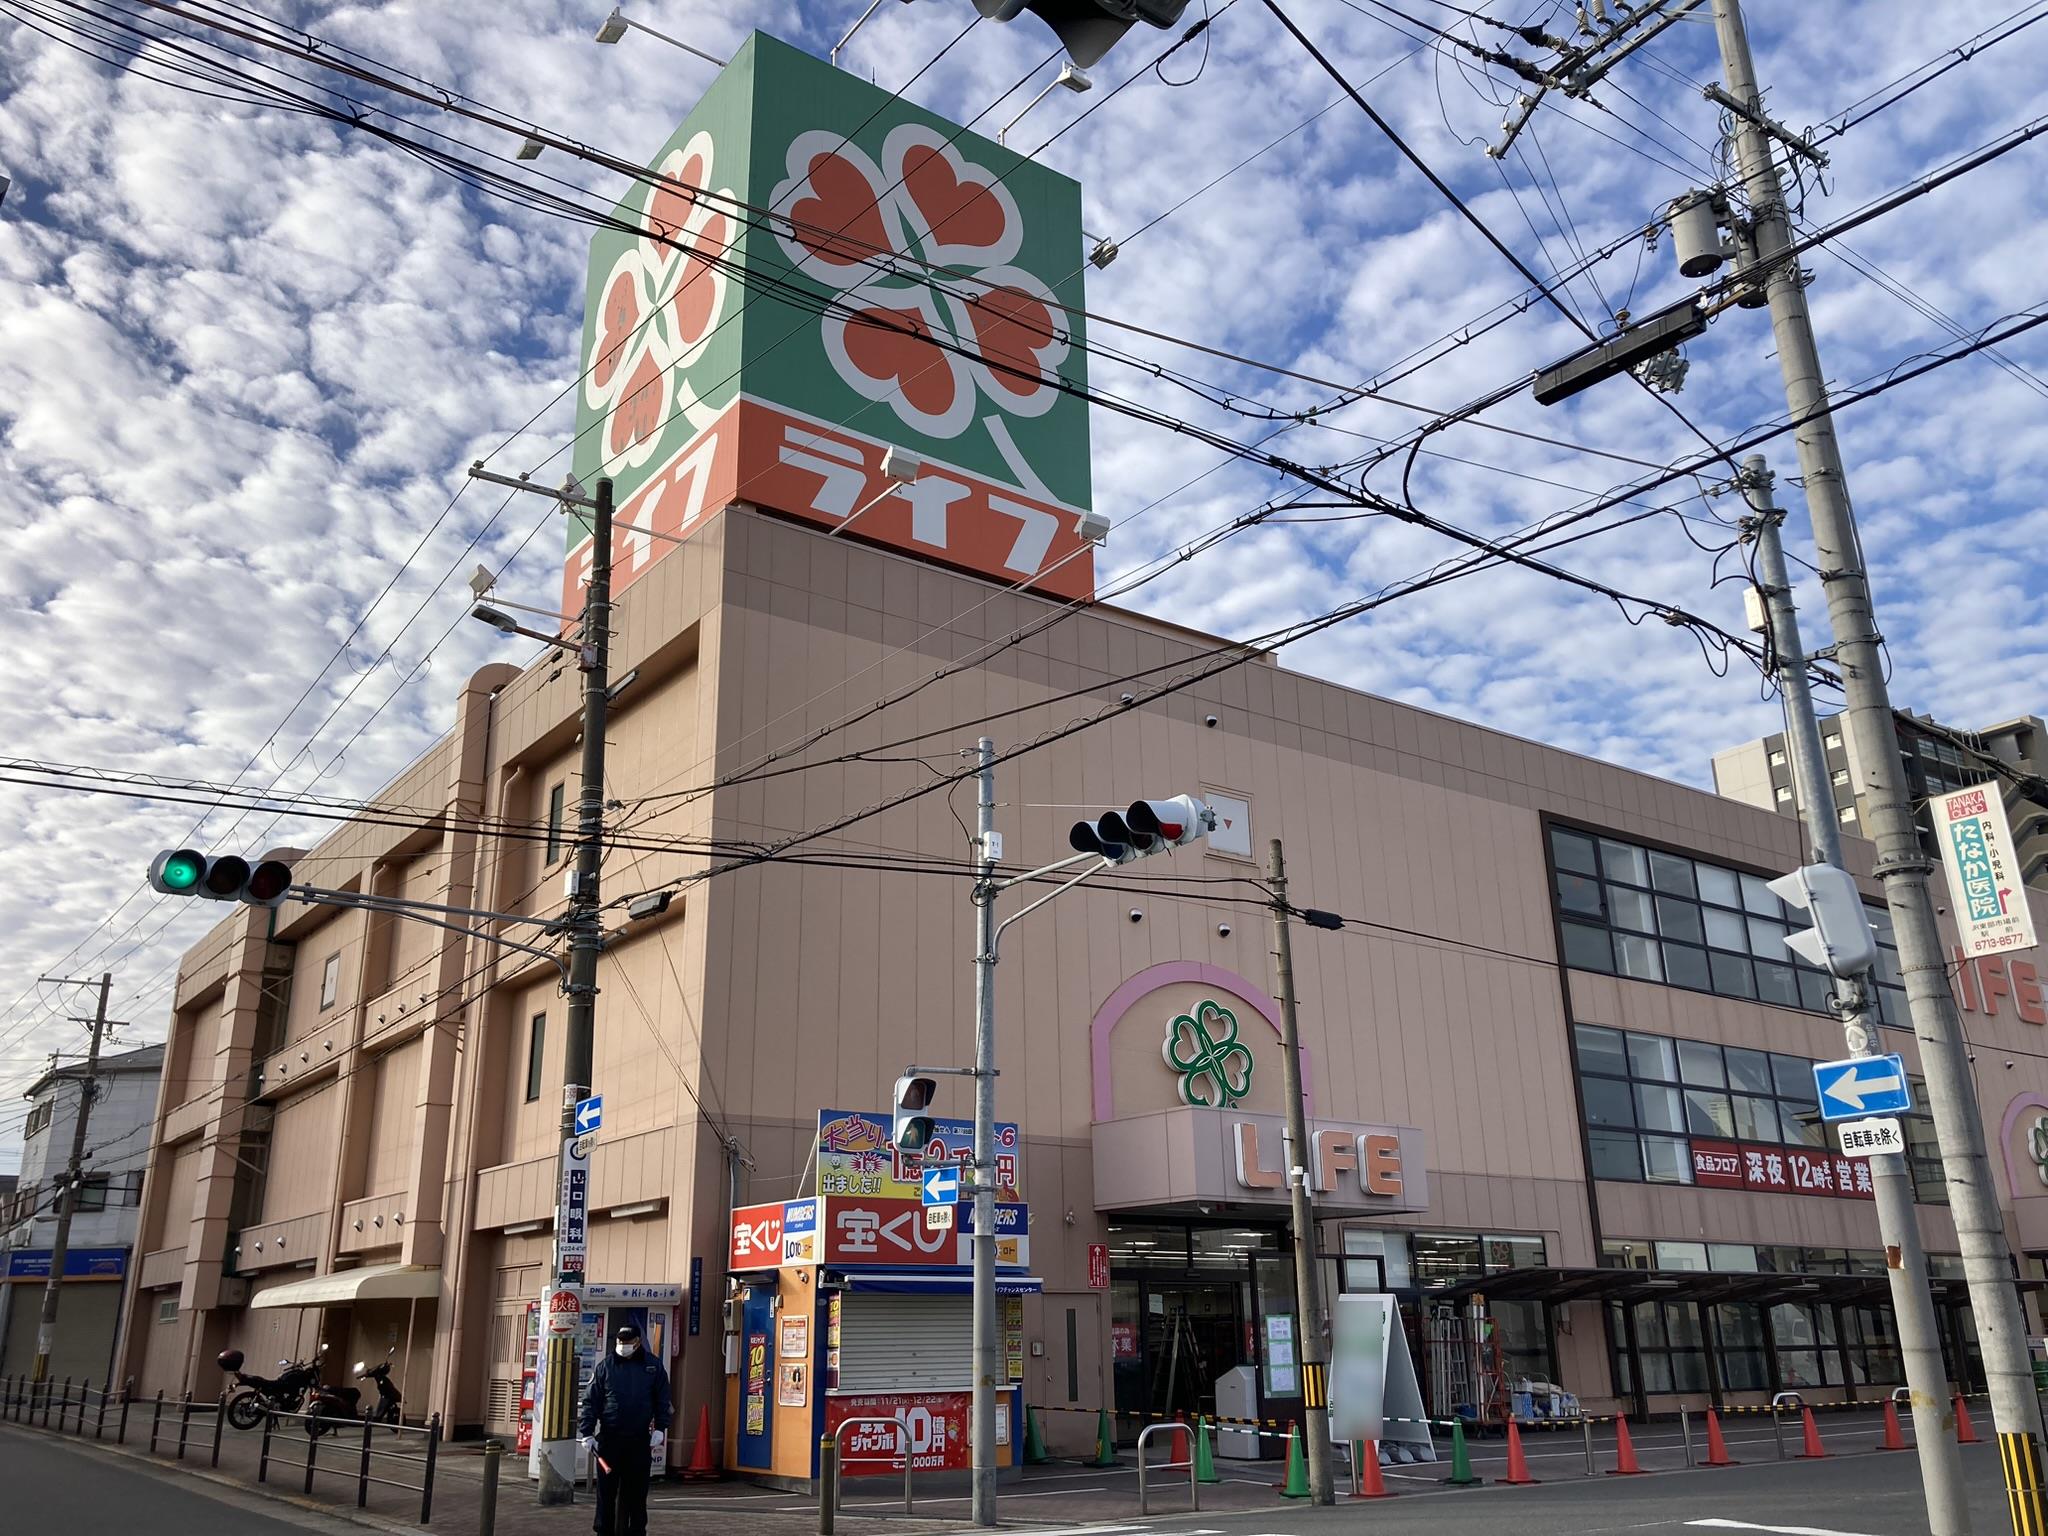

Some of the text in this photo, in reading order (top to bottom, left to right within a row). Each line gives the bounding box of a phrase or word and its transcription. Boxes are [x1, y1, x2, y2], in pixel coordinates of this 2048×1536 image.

[779, 425, 1059, 577] ライフ
[1946, 791, 1985, 811] TANAKA
[1951, 802, 1985, 818] CLINIC
[1981, 821, 2005, 882] 内科・小児科
[1953, 823, 1998, 917] たなか医院
[1974, 933, 2023, 951] 6713-8577
[823, 1113, 885, 1152] 大当り
[1842, 1128, 1900, 1149] 自転車を除く
[1695, 1153, 1738, 1174] 食品フロア
[569, 1172, 585, 1241] 山口眼科
[733, 1219, 781, 1256] 宝くじ
[589, 1287, 606, 1295] DNP
[550, 1297, 577, 1312] 消火栓
[750, 1345, 765, 1366] 10
[850, 1432, 895, 1452] ジャンボ
